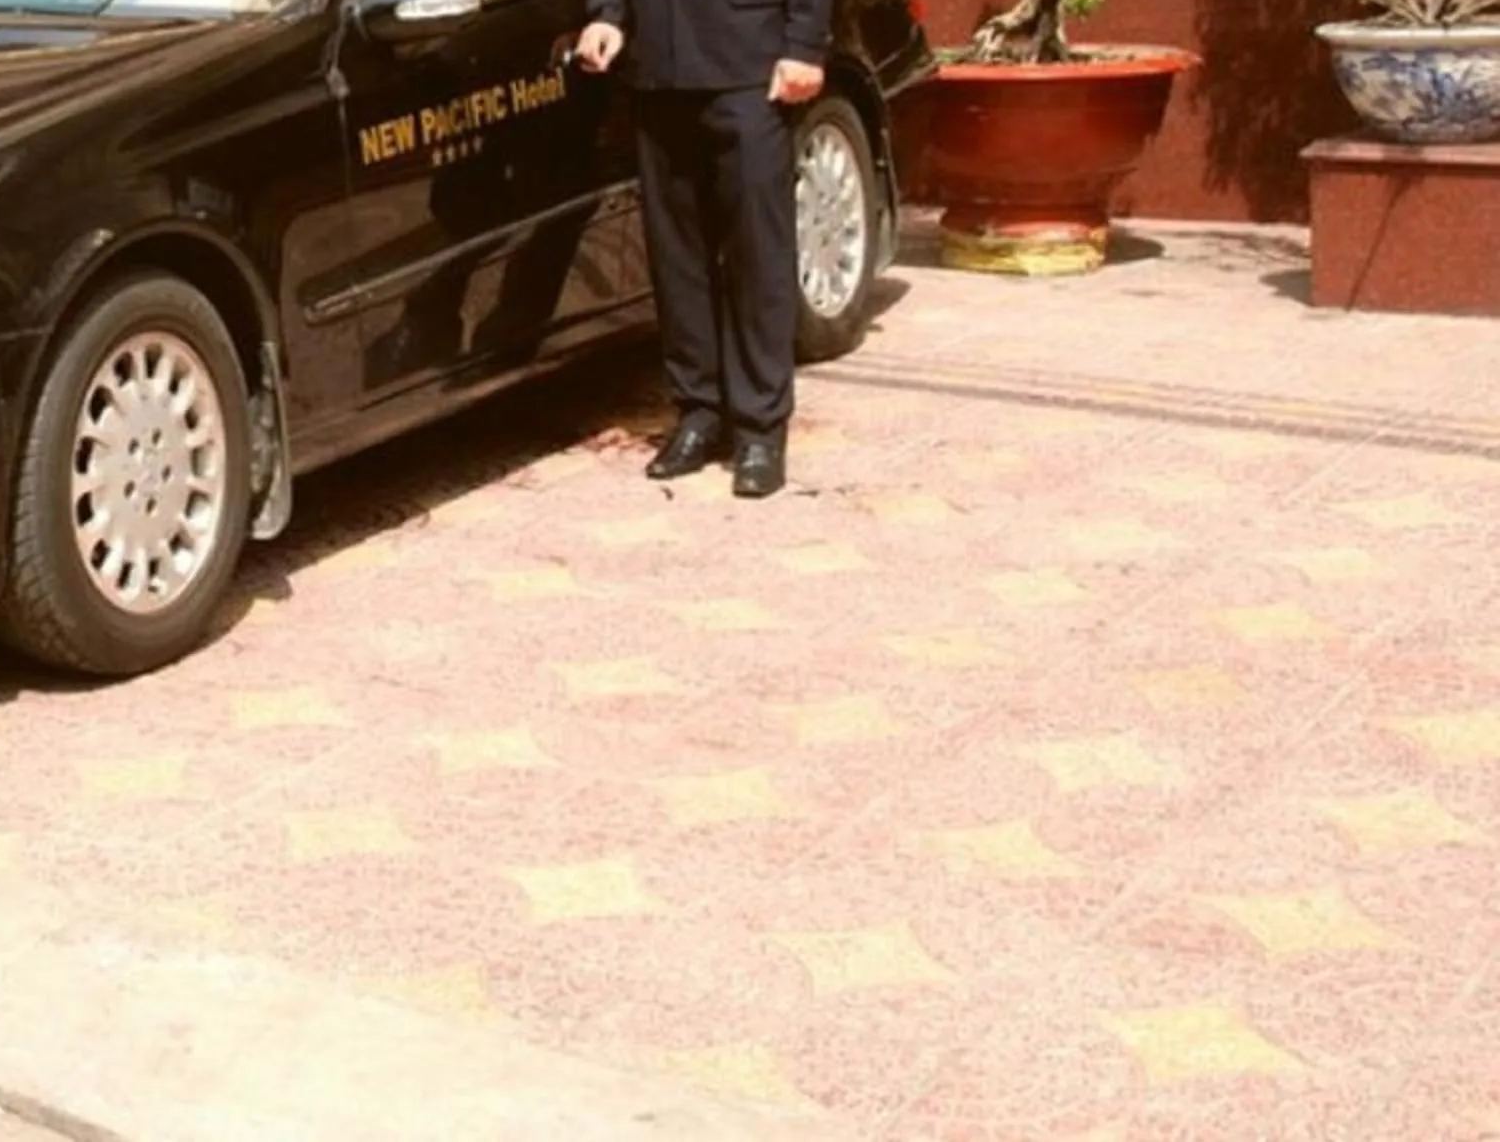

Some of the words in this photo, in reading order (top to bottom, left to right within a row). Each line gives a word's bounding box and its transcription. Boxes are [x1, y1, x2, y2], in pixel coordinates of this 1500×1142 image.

[359, 113, 415, 166] NEW
[420, 85, 507, 145] PACIFIC
[509, 66, 566, 114] Hotel
